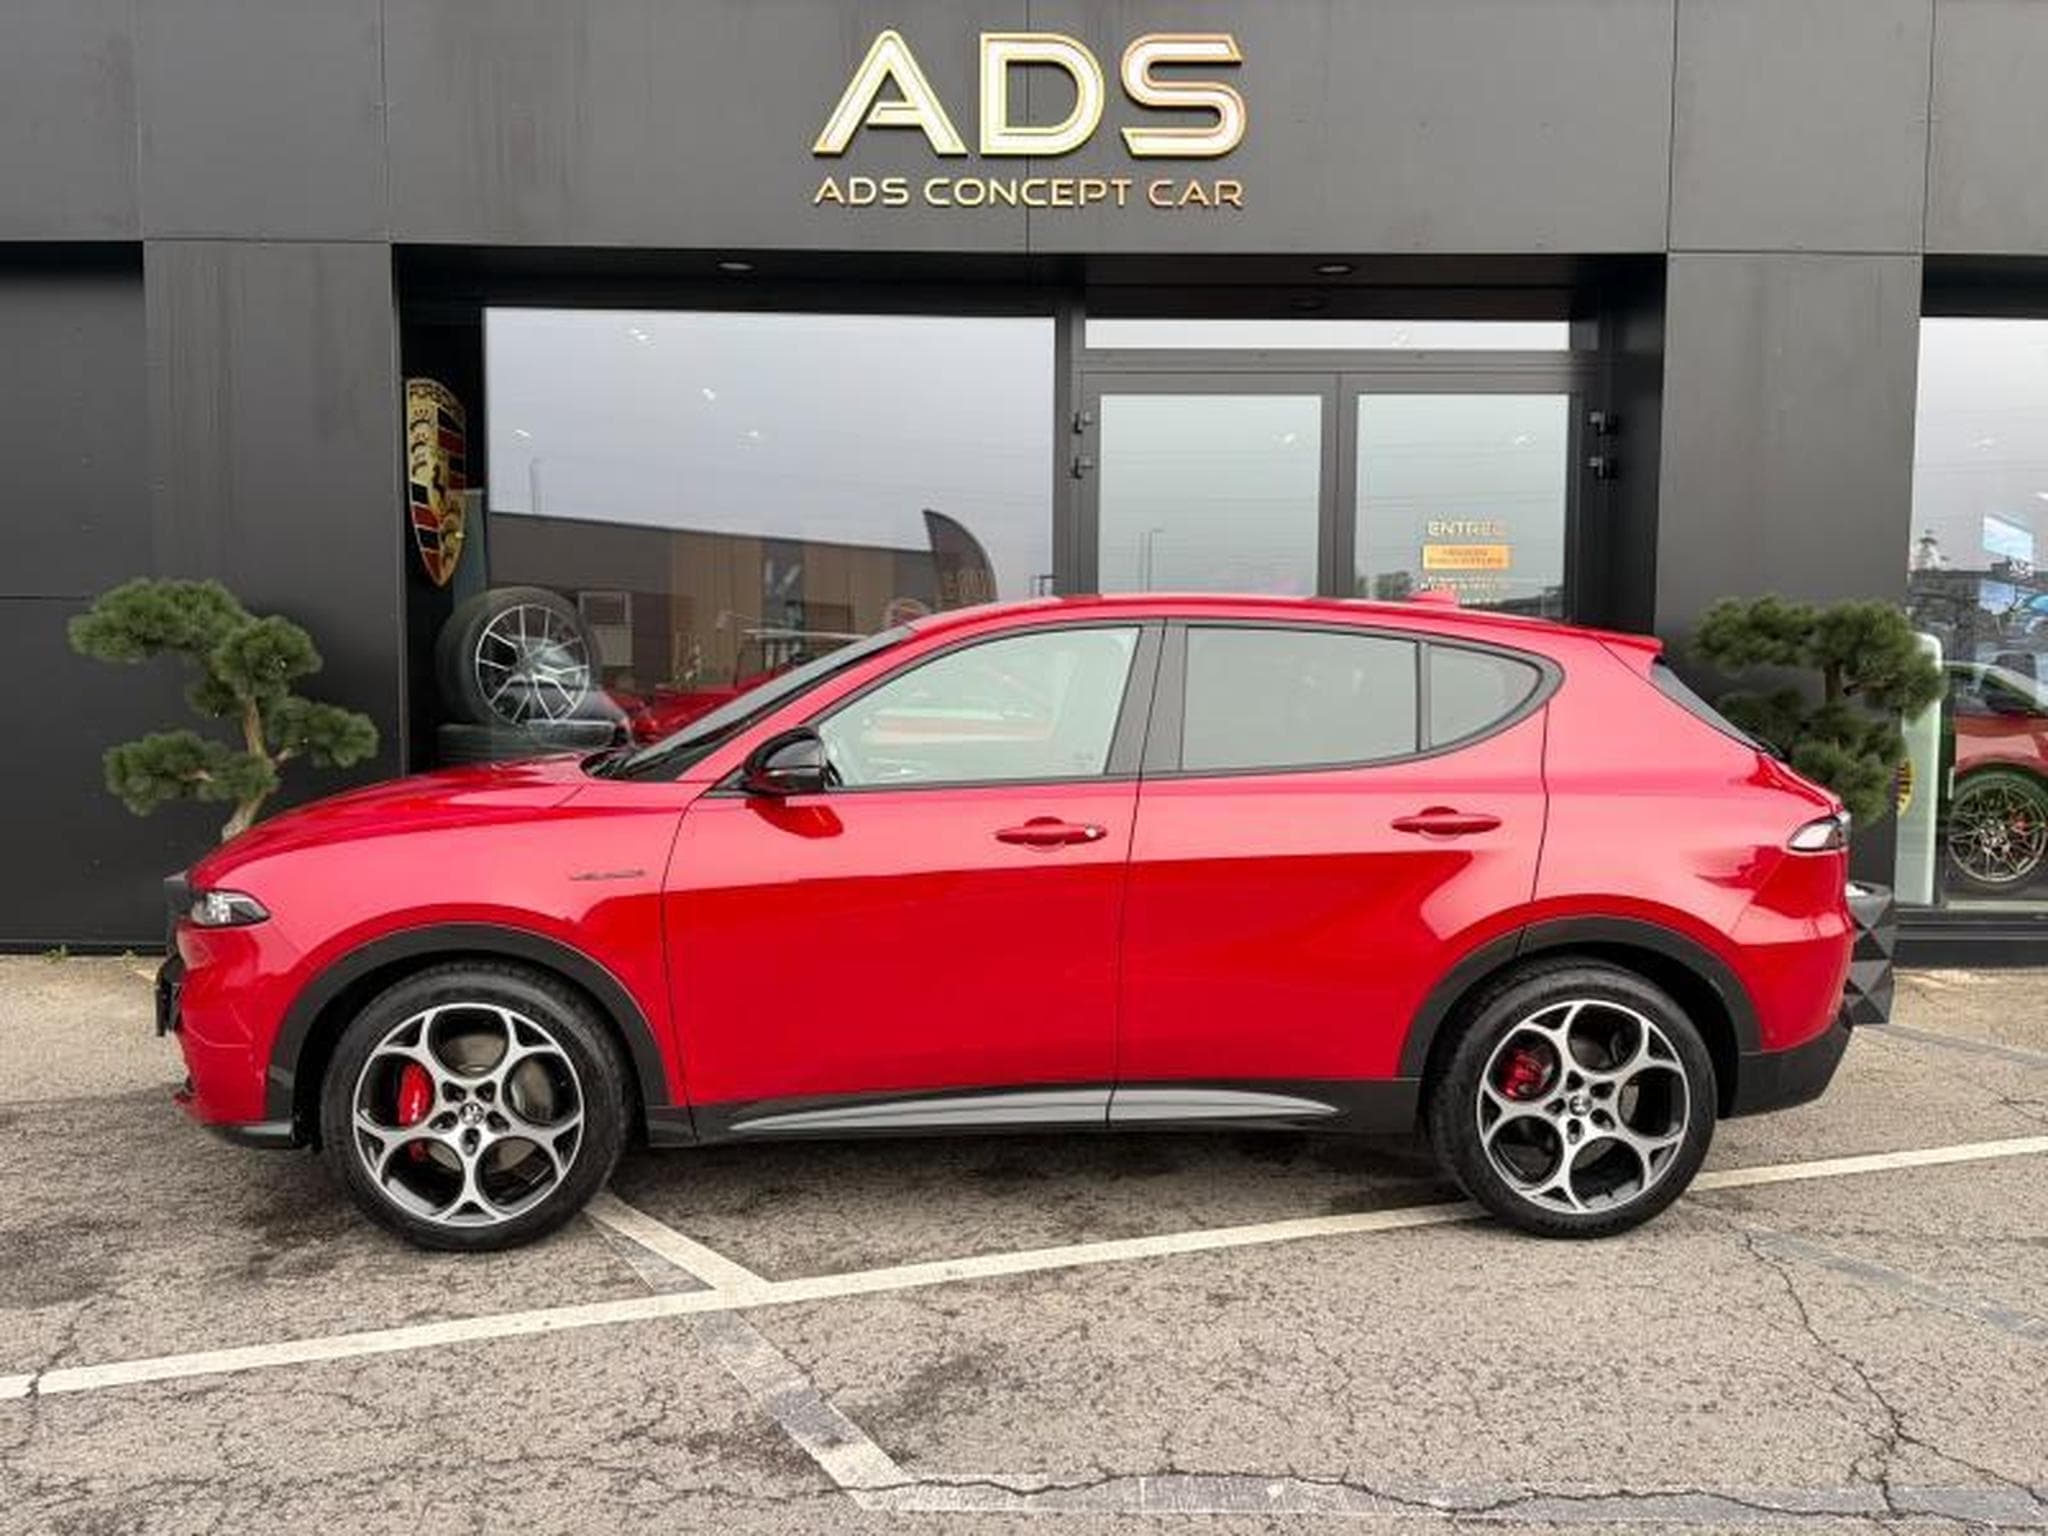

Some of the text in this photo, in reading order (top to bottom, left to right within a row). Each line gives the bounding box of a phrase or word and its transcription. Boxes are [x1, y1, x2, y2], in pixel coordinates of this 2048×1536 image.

[813, 29, 1247, 159] ADS
[813, 176, 1245, 209] ADS CONCEPT CAR
